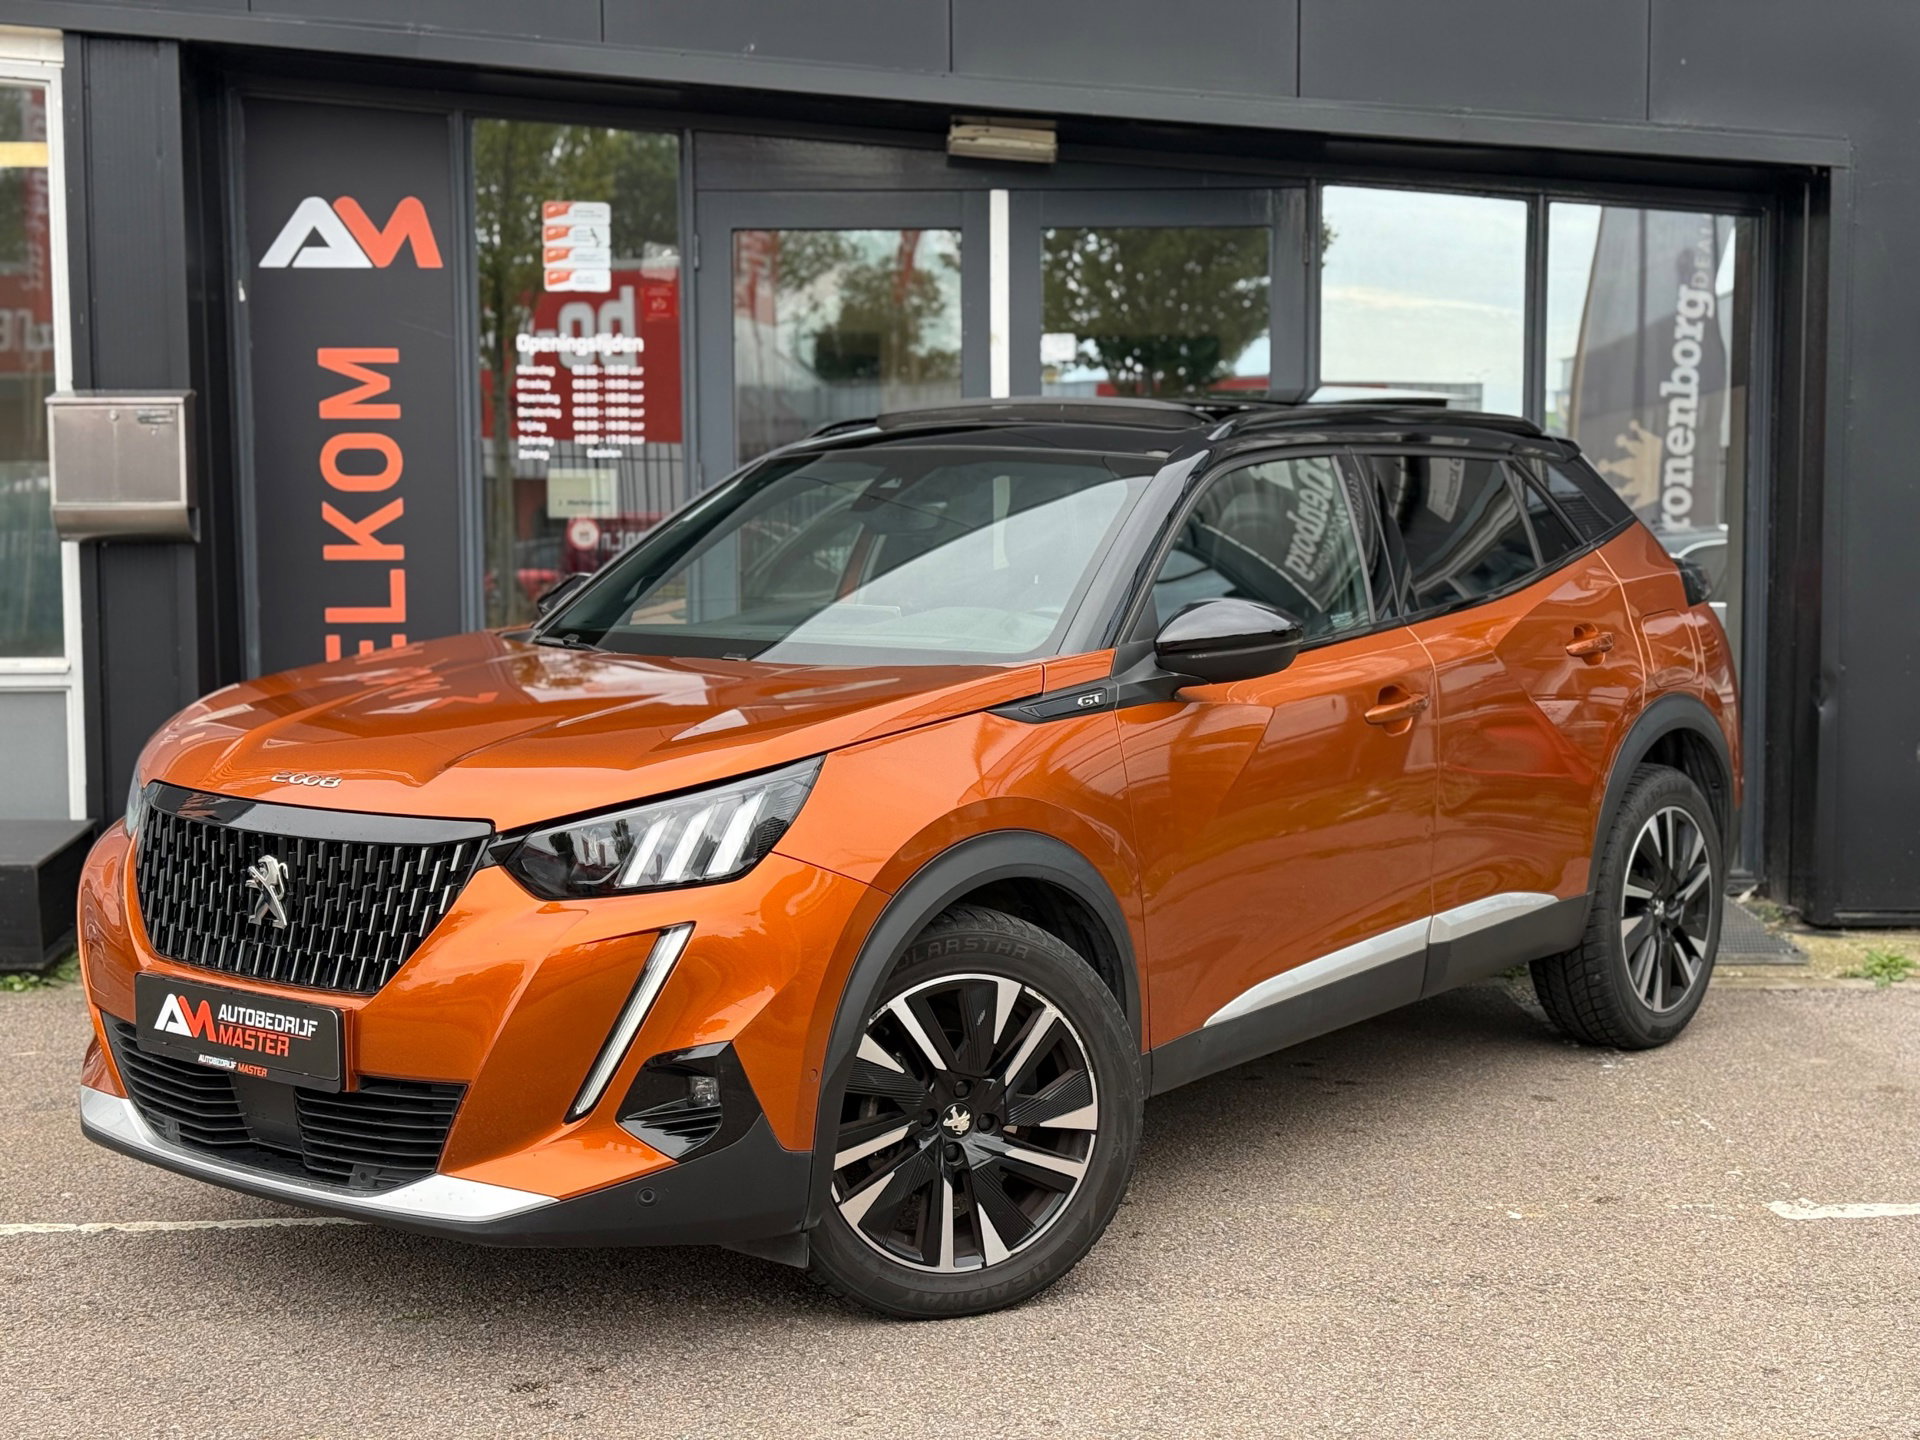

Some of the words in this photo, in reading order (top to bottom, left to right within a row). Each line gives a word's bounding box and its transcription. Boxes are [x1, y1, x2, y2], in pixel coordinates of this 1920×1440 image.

[258, 196, 443, 269] AM
[1077, 692, 1103, 707] GT
[270, 772, 342, 788] 2008
[154, 993, 217, 1043] AM
[218, 1004, 319, 1037] AUTOBEDRIJF
[218, 1024, 290, 1058] MASTER
[237, 1063, 268, 1078] MASTER
